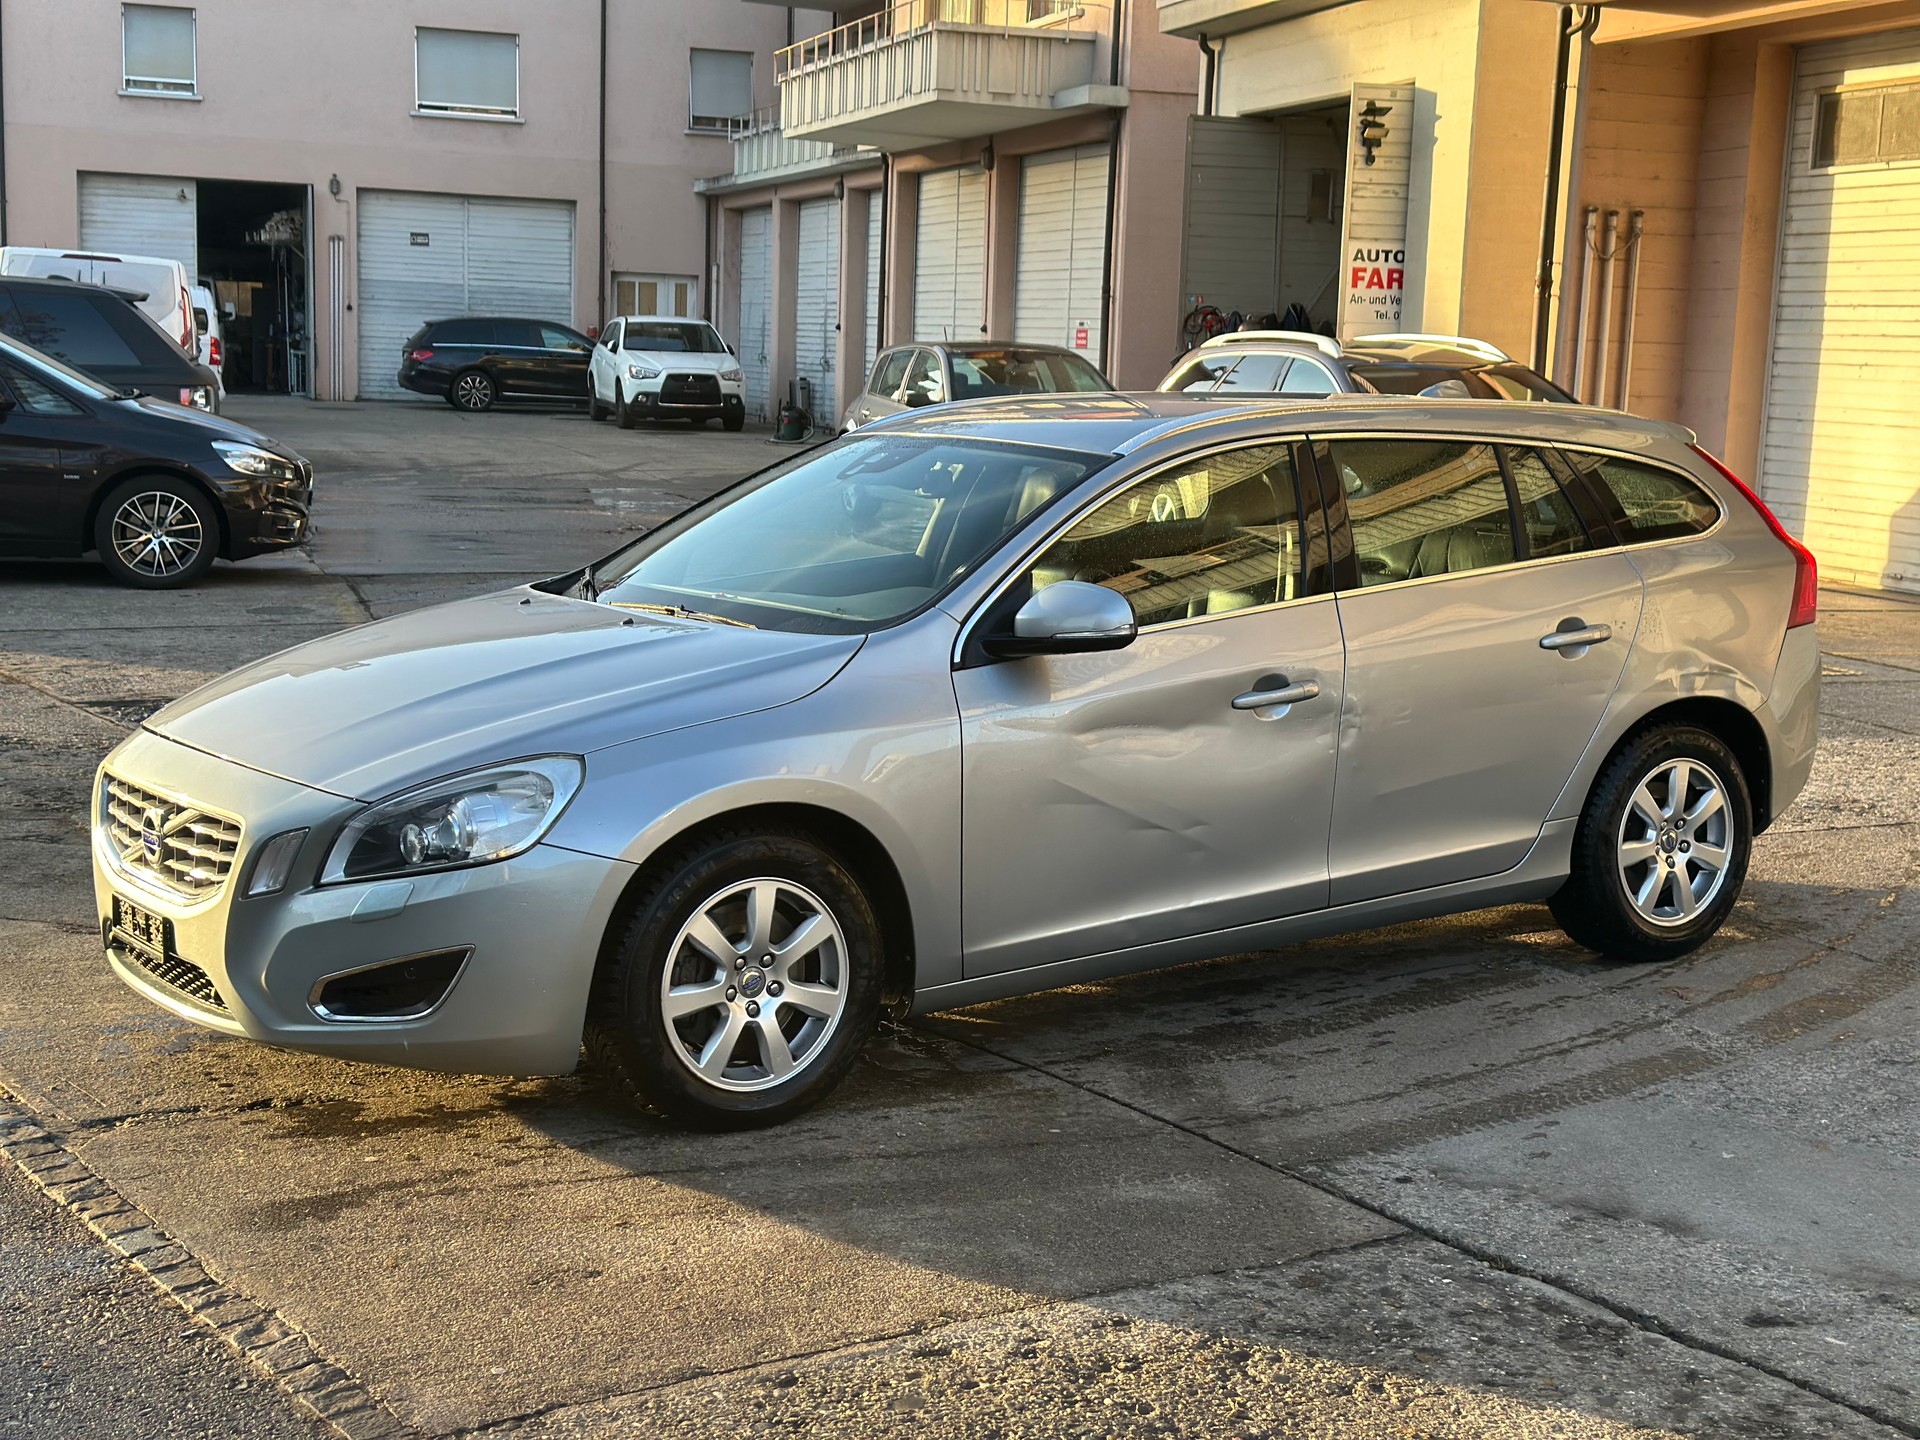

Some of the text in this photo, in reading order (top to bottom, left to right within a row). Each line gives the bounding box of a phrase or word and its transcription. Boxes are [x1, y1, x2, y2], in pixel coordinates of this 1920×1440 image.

[1352, 248, 1405, 263] AUTO
[1351, 266, 1404, 290] FAR
[1350, 293, 1366, 304] An-
[1368, 294, 1387, 305] und
[1374, 310, 1391, 320] Tel.
